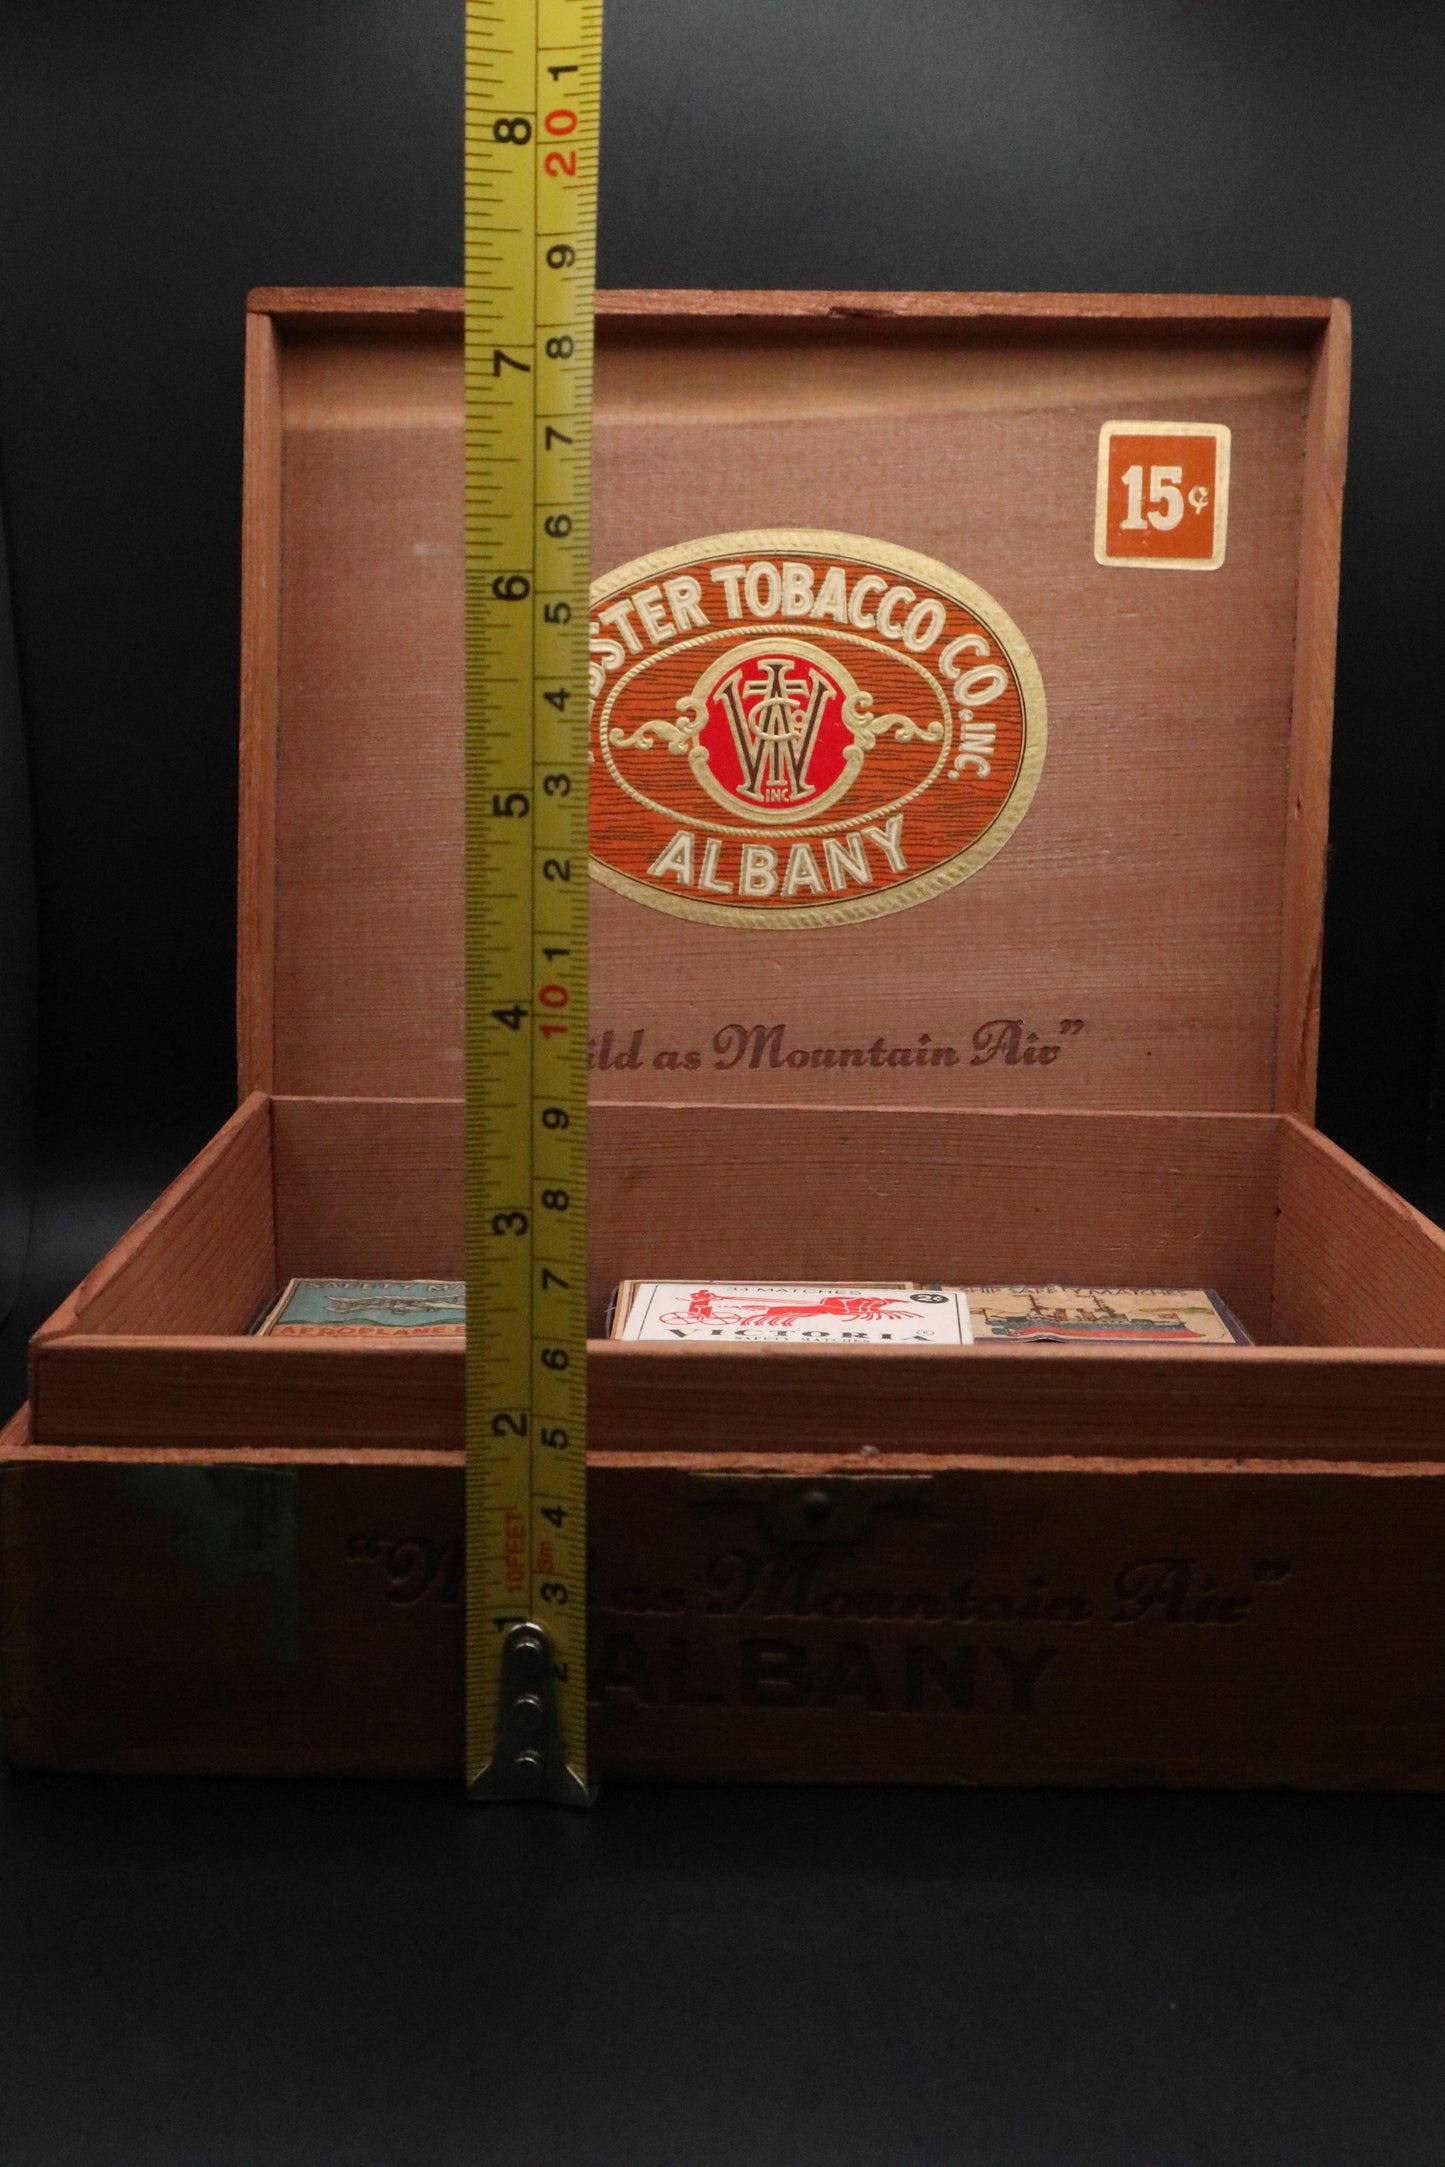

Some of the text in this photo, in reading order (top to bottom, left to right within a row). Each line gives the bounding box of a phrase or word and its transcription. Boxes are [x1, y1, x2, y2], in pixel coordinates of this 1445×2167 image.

[547, 64, 579, 81] 1
[493, 116, 533, 145] 8
[544, 108, 578, 177] 20
[546, 244, 576, 270] 9
[546, 334, 575, 359] 8
[493, 349, 531, 378] 7
[545, 425, 573, 451] 7
[544, 512, 573, 539] 6
[492, 574, 531, 602] 6
[544, 601, 572, 625] 5
[710, 561, 947, 653] TOBACCO
[543, 687, 571, 711] 4
[543, 773, 572, 797] 3
[492, 792, 530, 818] 5
[647, 813, 909, 897] ALBANY
[543, 858, 571, 882] 2
[543, 945, 571, 962] 1
[492, 1004, 529, 1031] 4
[539, 983, 570, 1038] 10
[653, 1050, 701, 1070] as
[712, 1023, 960, 1070] Mountain
[542, 1107, 569, 1130] 9
[542, 1188, 569, 1212] 8
[492, 1210, 529, 1237] 3
[306, 1281, 412, 1290] SAFETY
[542, 1267, 569, 1291] 7
[757, 1287, 863, 1296] MATCHES
[279, 1326, 449, 1336] AEROPLANE
[665, 1328, 936, 1343] VICTORIA
[542, 1347, 569, 1371] 6
[491, 1413, 528, 1438] 2
[541, 1426, 568, 1450] 5
[541, 1504, 568, 1529] 4
[541, 1582, 569, 1606] 3
[704, 1551, 1090, 1620] Mountain
[589, 1632, 1061, 1714] ALBANY
